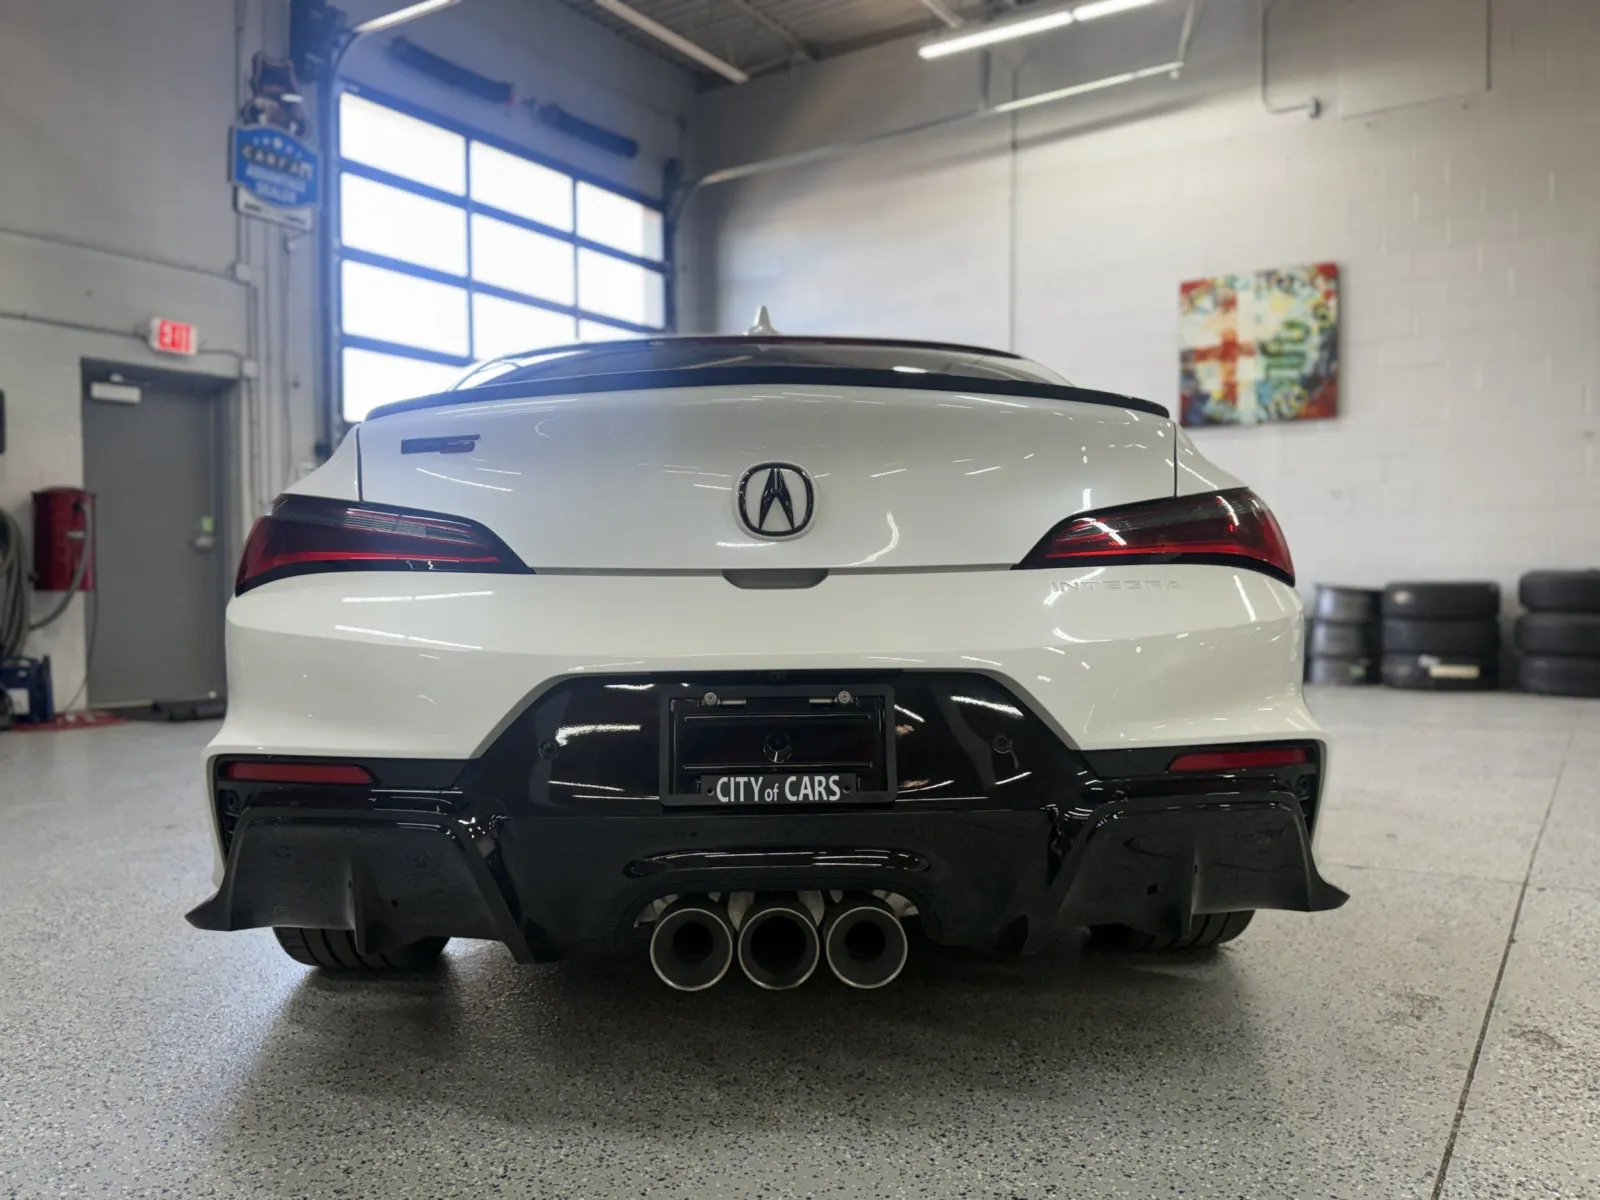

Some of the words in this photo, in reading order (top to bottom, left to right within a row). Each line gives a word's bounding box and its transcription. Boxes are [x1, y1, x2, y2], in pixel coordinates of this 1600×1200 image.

[158, 319, 192, 352] EXIT
[1051, 580, 1186, 592] INTEGRA
[716, 776, 763, 802] CITY
[764, 783, 779, 801] of
[785, 775, 840, 801] CARS
